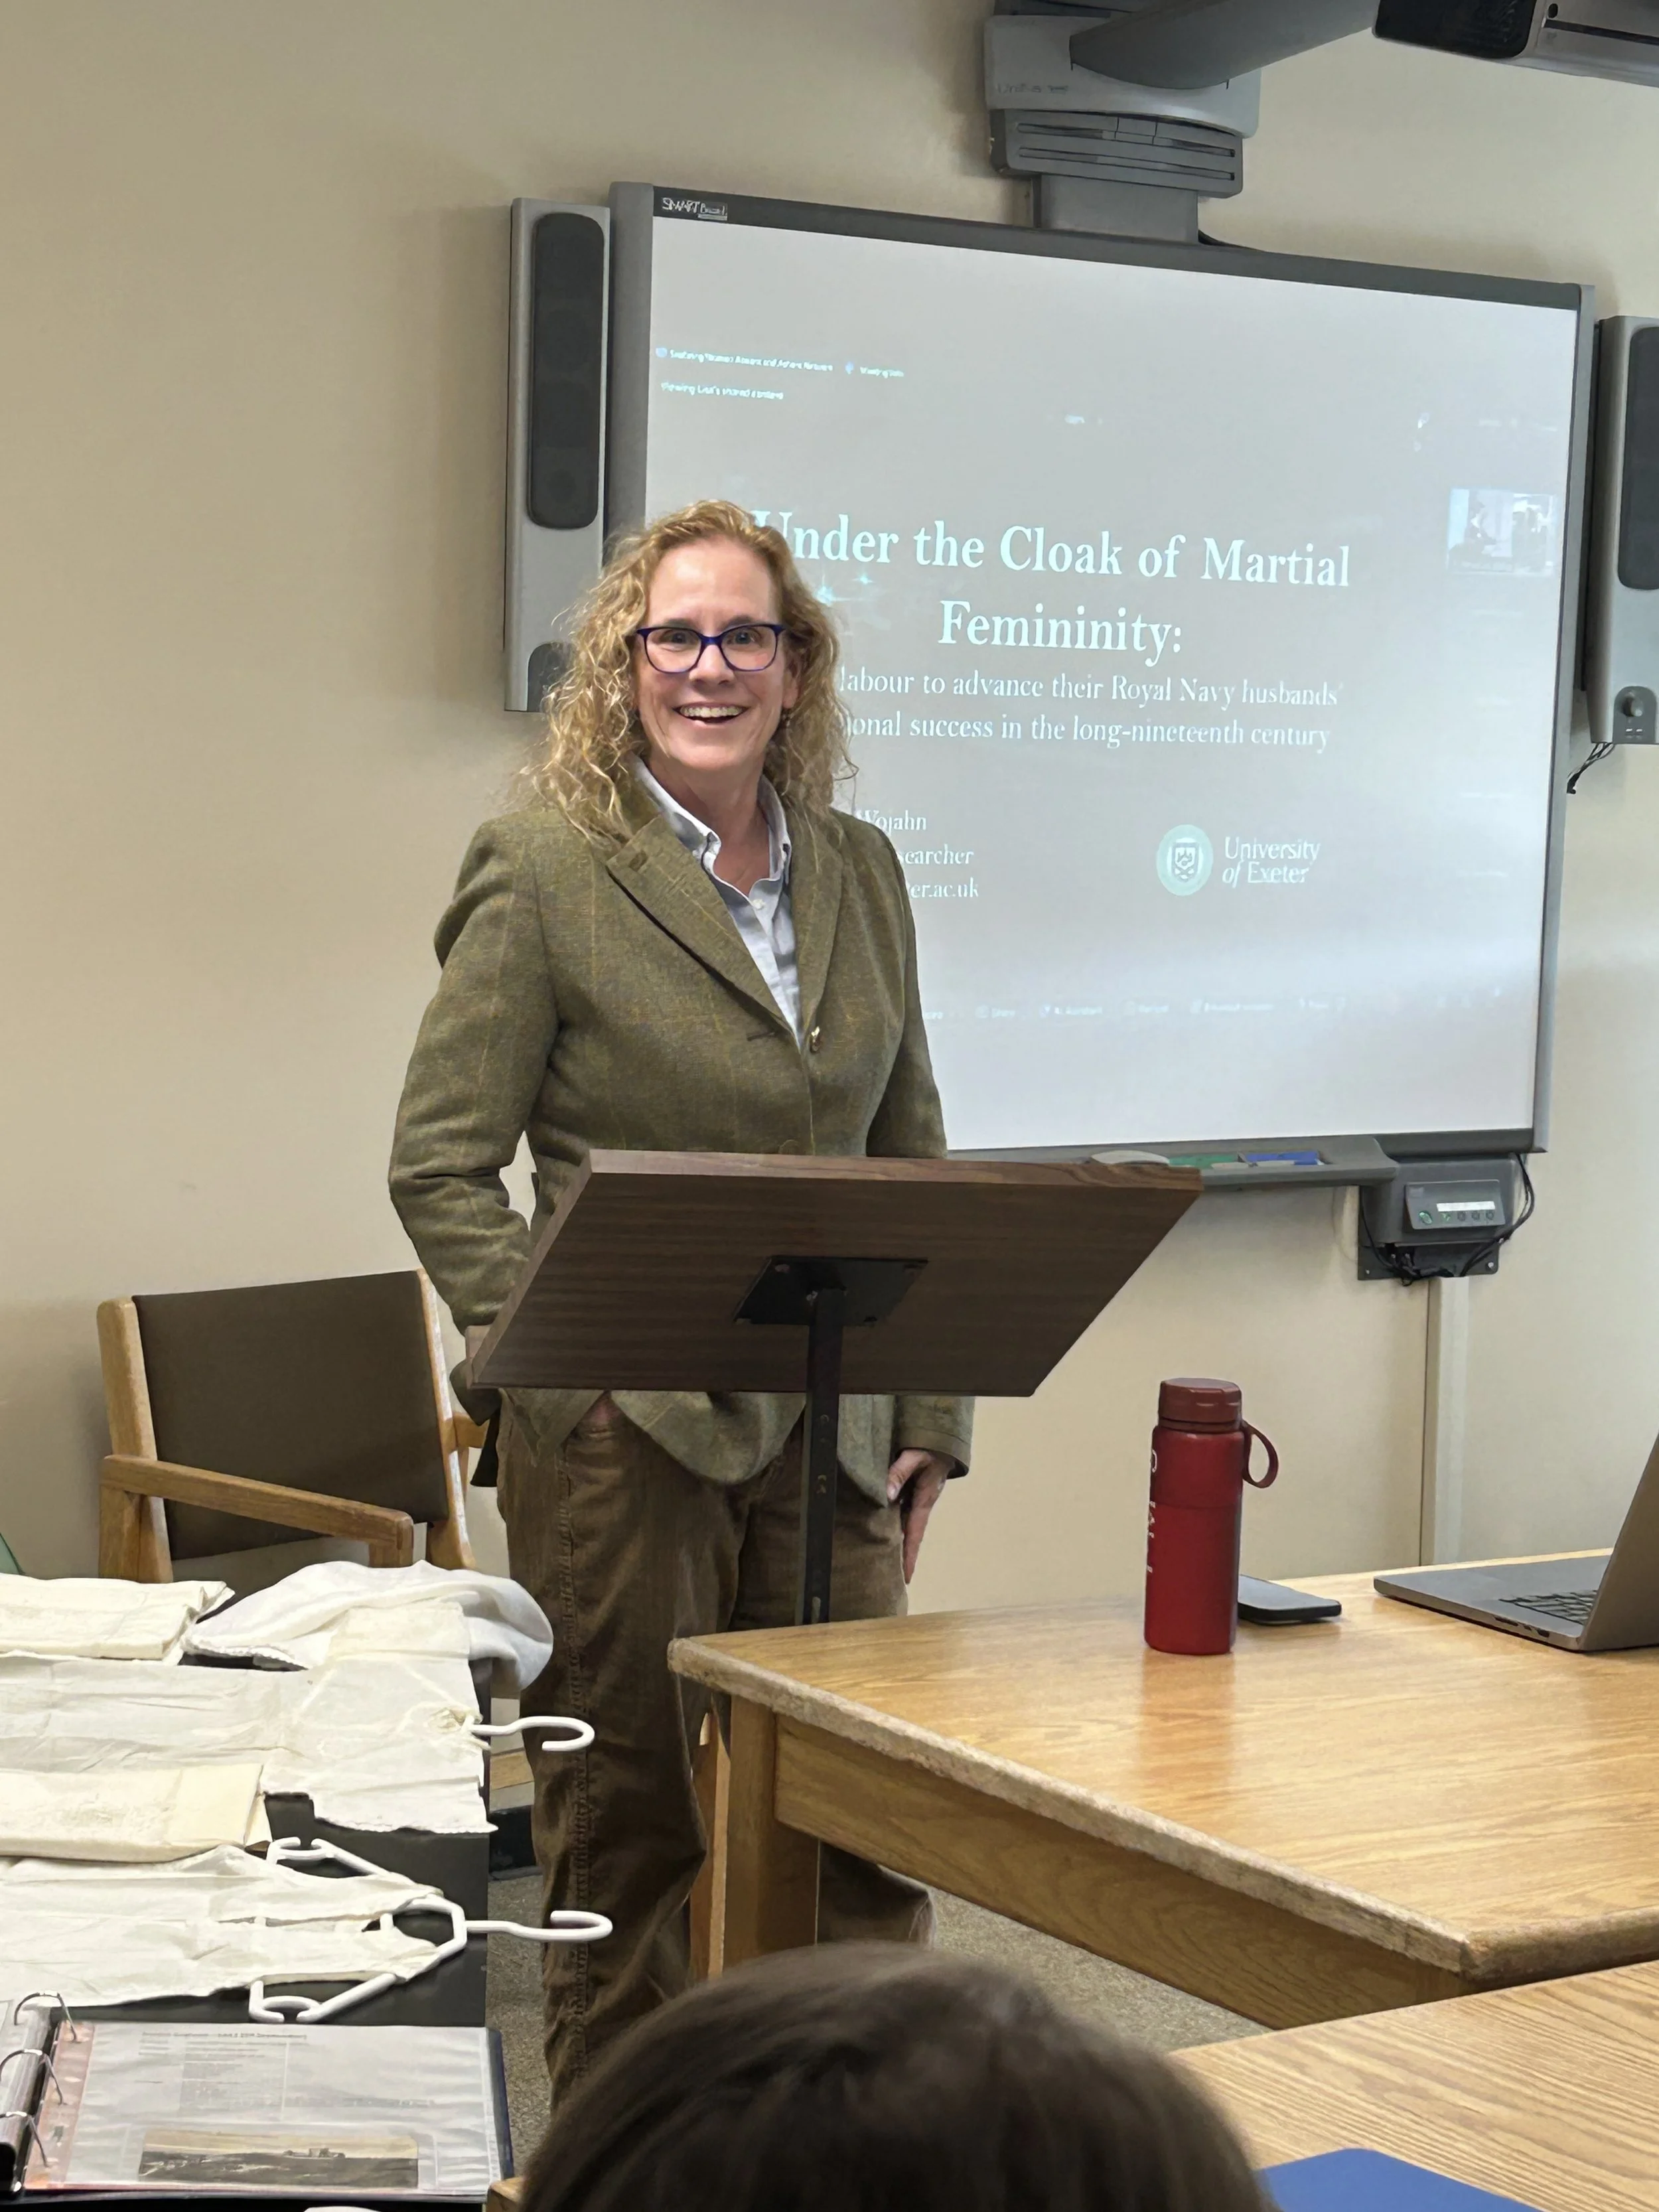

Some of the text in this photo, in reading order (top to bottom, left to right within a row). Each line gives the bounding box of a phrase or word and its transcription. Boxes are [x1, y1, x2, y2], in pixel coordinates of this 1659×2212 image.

[913, 520, 984, 567] the
[1001, 526, 1122, 574] Cloak
[1139, 535, 1186, 577] of
[1201, 538, 1348, 586] Martial
[938, 601, 1181, 666] Femininity:
[839, 666, 914, 694] labour
[924, 676, 945, 694] to
[954, 670, 1043, 696] advance
[1052, 673, 1104, 698] their
[1112, 676, 1171, 708] Royal
[1180, 678, 1234, 711] Navy
[910, 719, 993, 737] success
[1002, 714, 1021, 739] in
[1032, 714, 1065, 739] the
[1074, 715, 1243, 748] long-nineteenth
[1251, 726, 1330, 754] century
[897, 844, 974, 865] earcher
[1225, 836, 1321, 866] University
[1222, 860, 1309, 889] of Exeter
